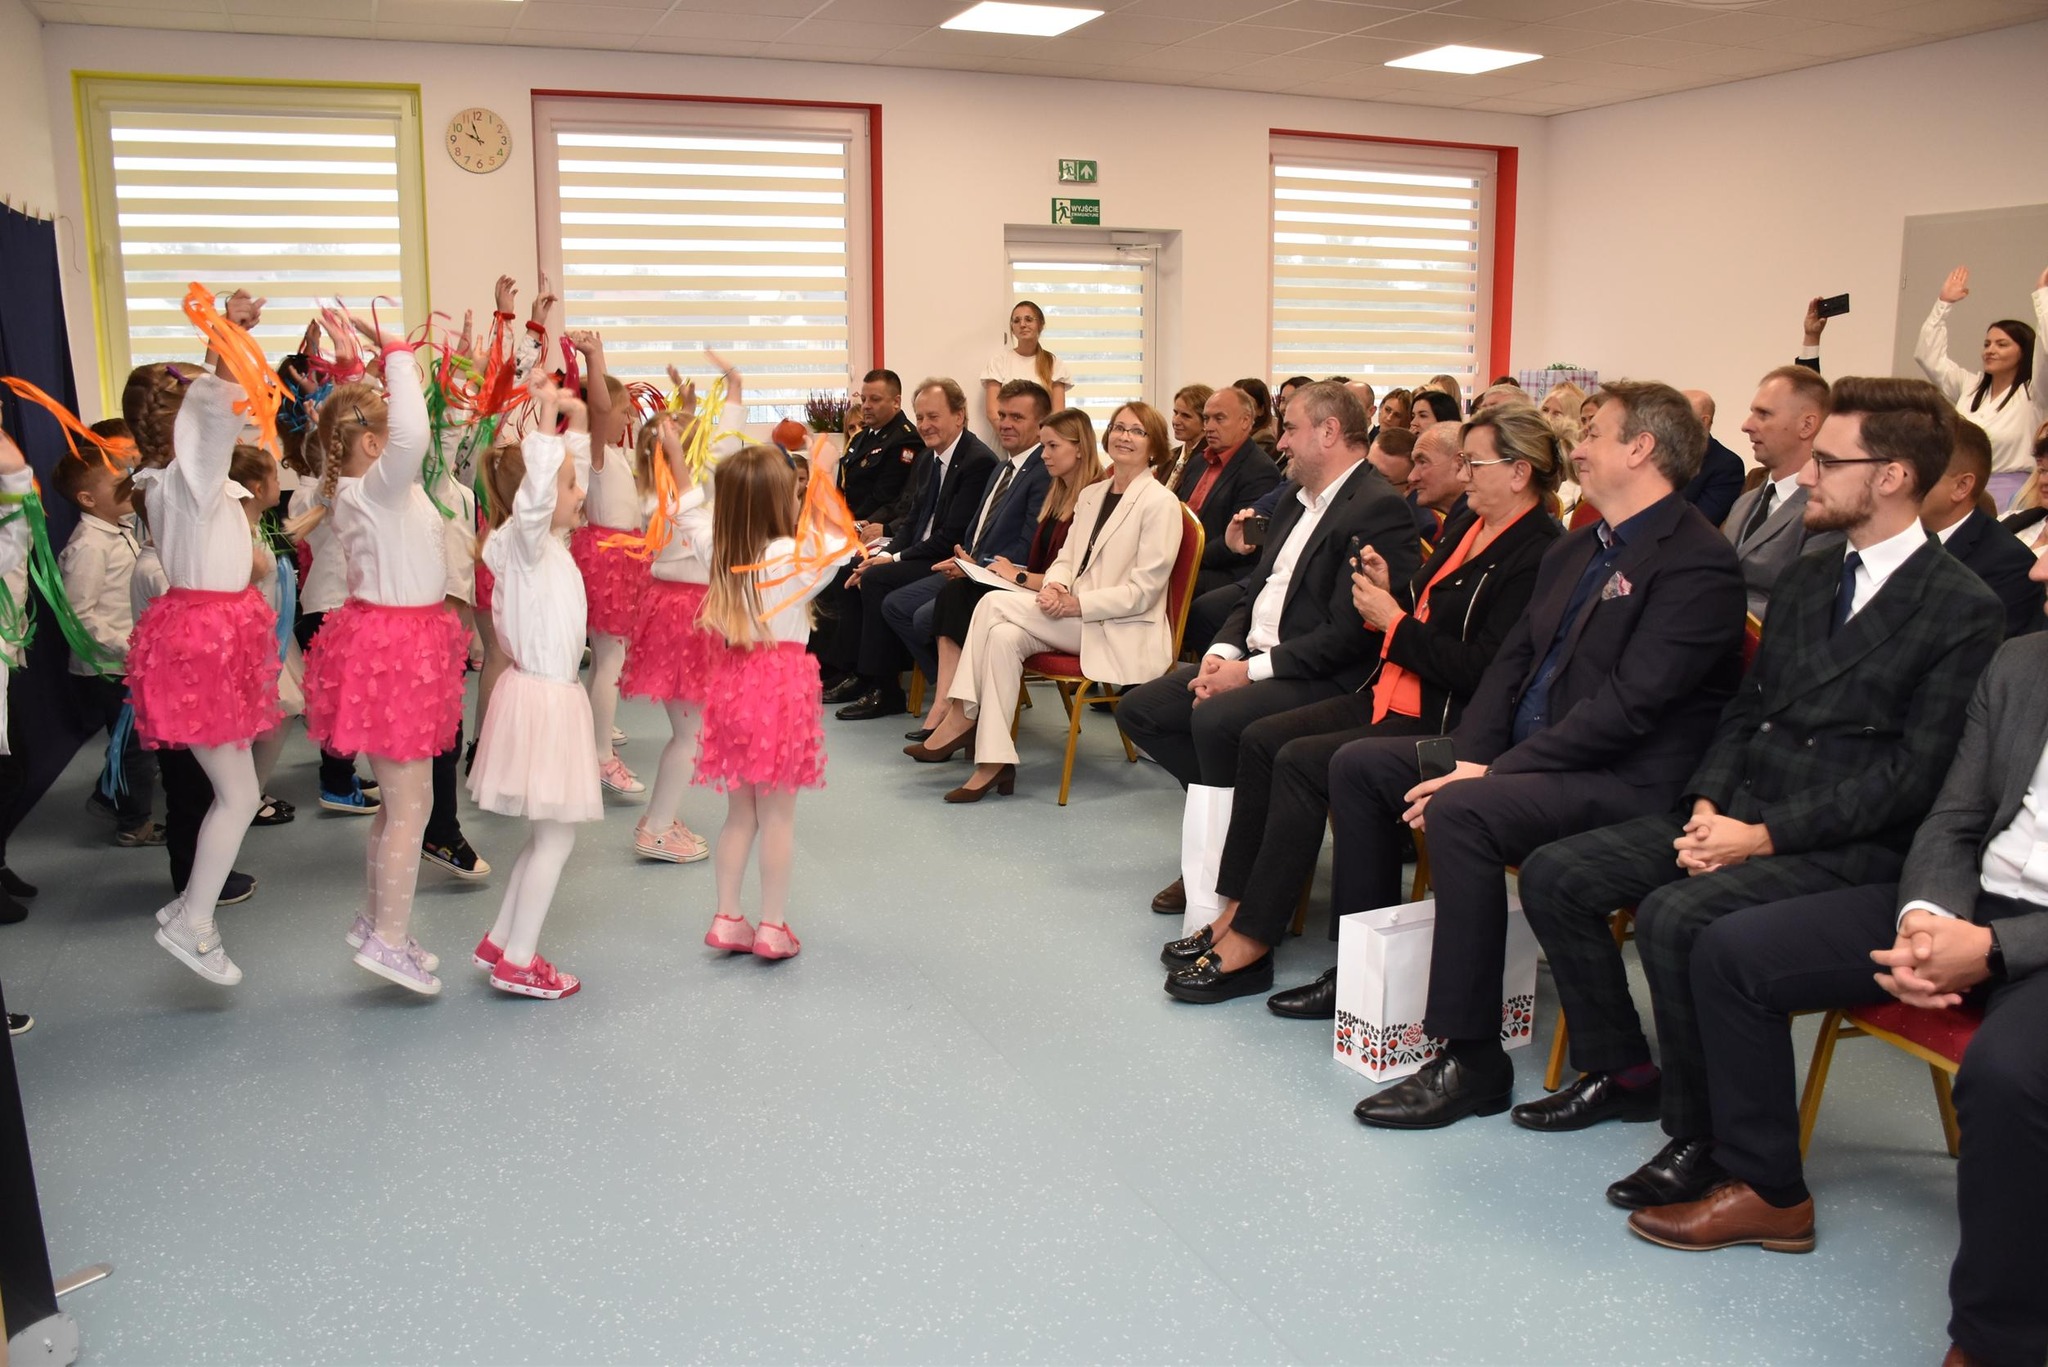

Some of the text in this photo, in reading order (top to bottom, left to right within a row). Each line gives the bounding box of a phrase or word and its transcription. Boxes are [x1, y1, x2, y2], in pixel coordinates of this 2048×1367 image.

[463, 114, 470, 124] 11
[473, 111, 482, 121] 12
[453, 123, 462, 133] 10
[496, 124, 503, 133] 2
[450, 134, 457, 144] 9
[501, 136, 507, 145] 3
[455, 147, 461, 156] 8
[497, 148, 503, 156] 4
[464, 156, 471, 164] 7
[476, 159, 483, 169] 6
[489, 156, 495, 165] 5
[1071, 204, 1099, 213] WYJŚCIE
